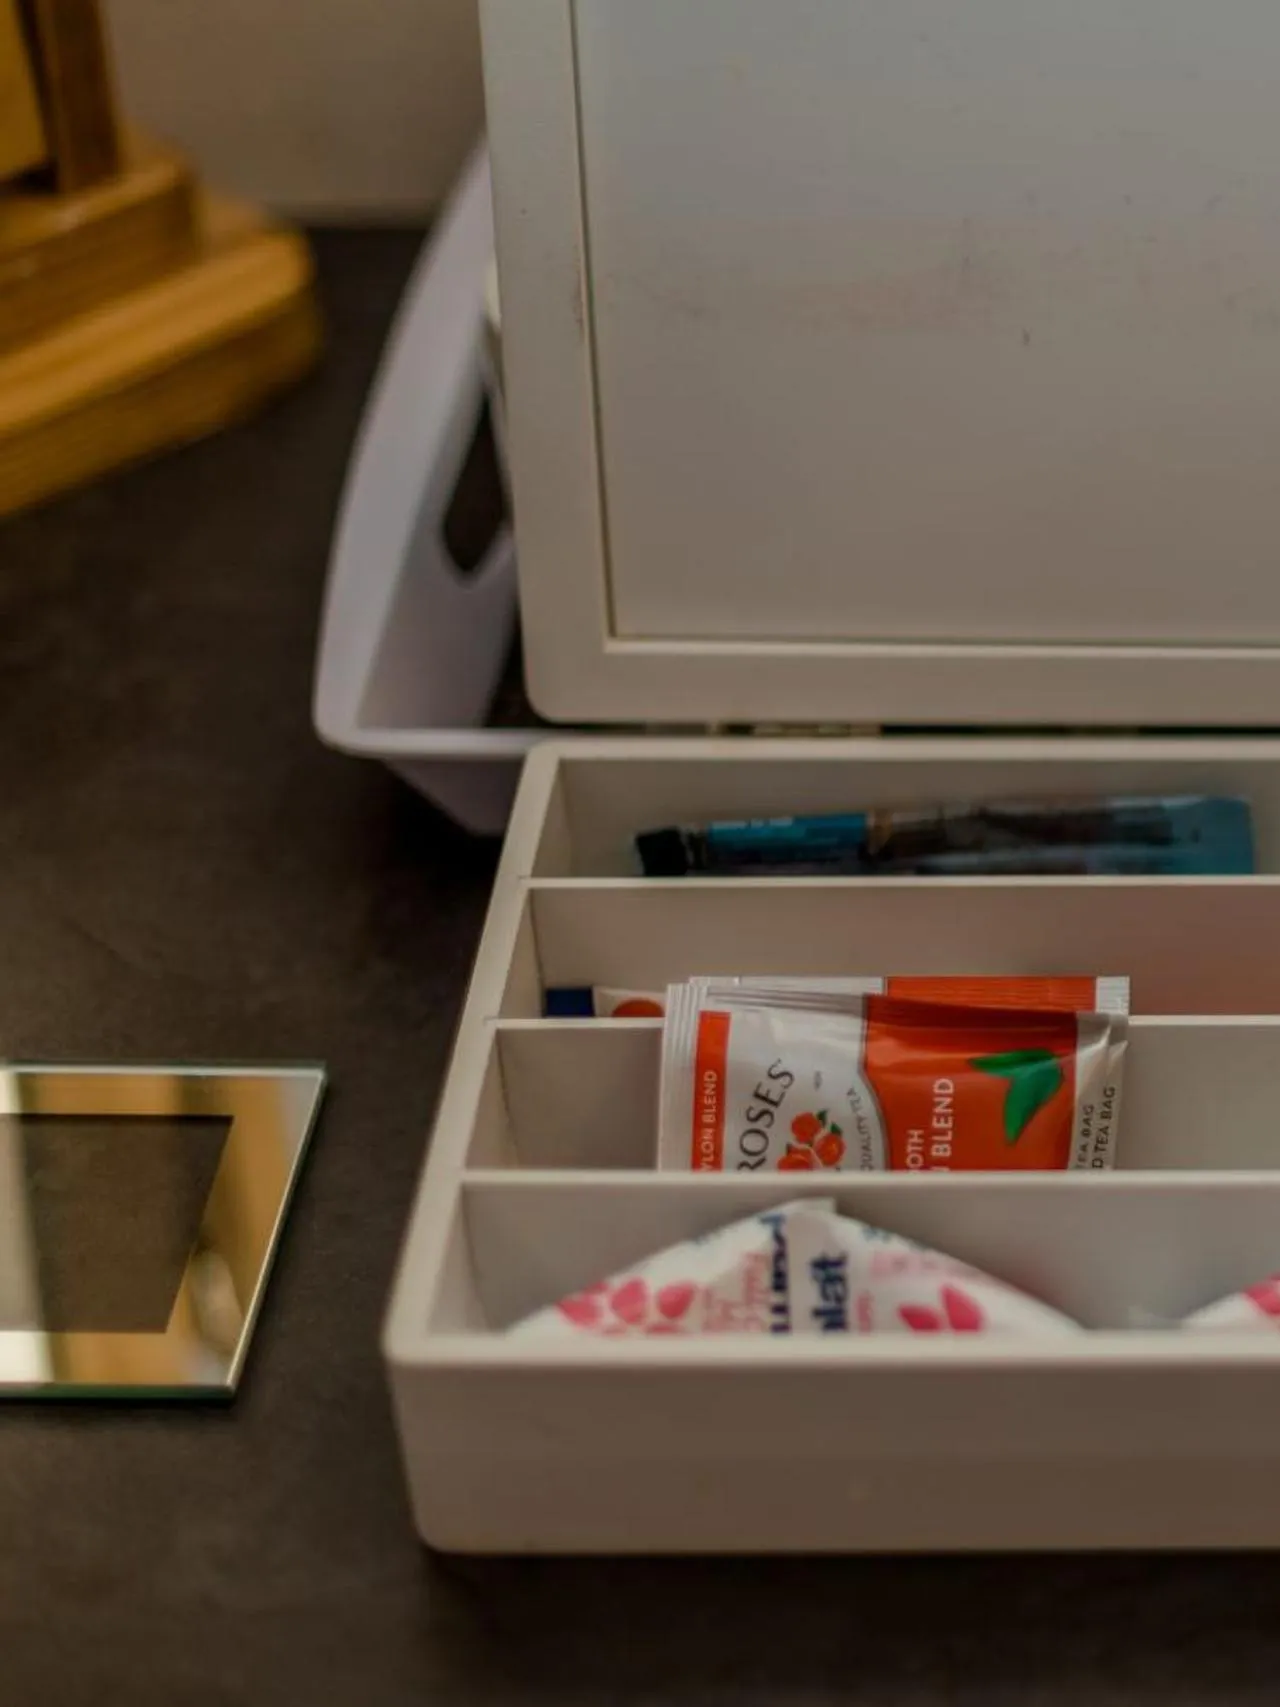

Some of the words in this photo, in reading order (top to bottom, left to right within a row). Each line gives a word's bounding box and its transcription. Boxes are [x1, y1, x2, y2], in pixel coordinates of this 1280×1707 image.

[701, 1069, 718, 1123] BLEND
[736, 1057, 795, 1171] ROSES
[931, 1078, 954, 1157] BLEND
[1100, 1086, 1115, 1120] BAG
[905, 1129, 924, 1172] OTH
[1094, 1126, 1109, 1153] TEA
